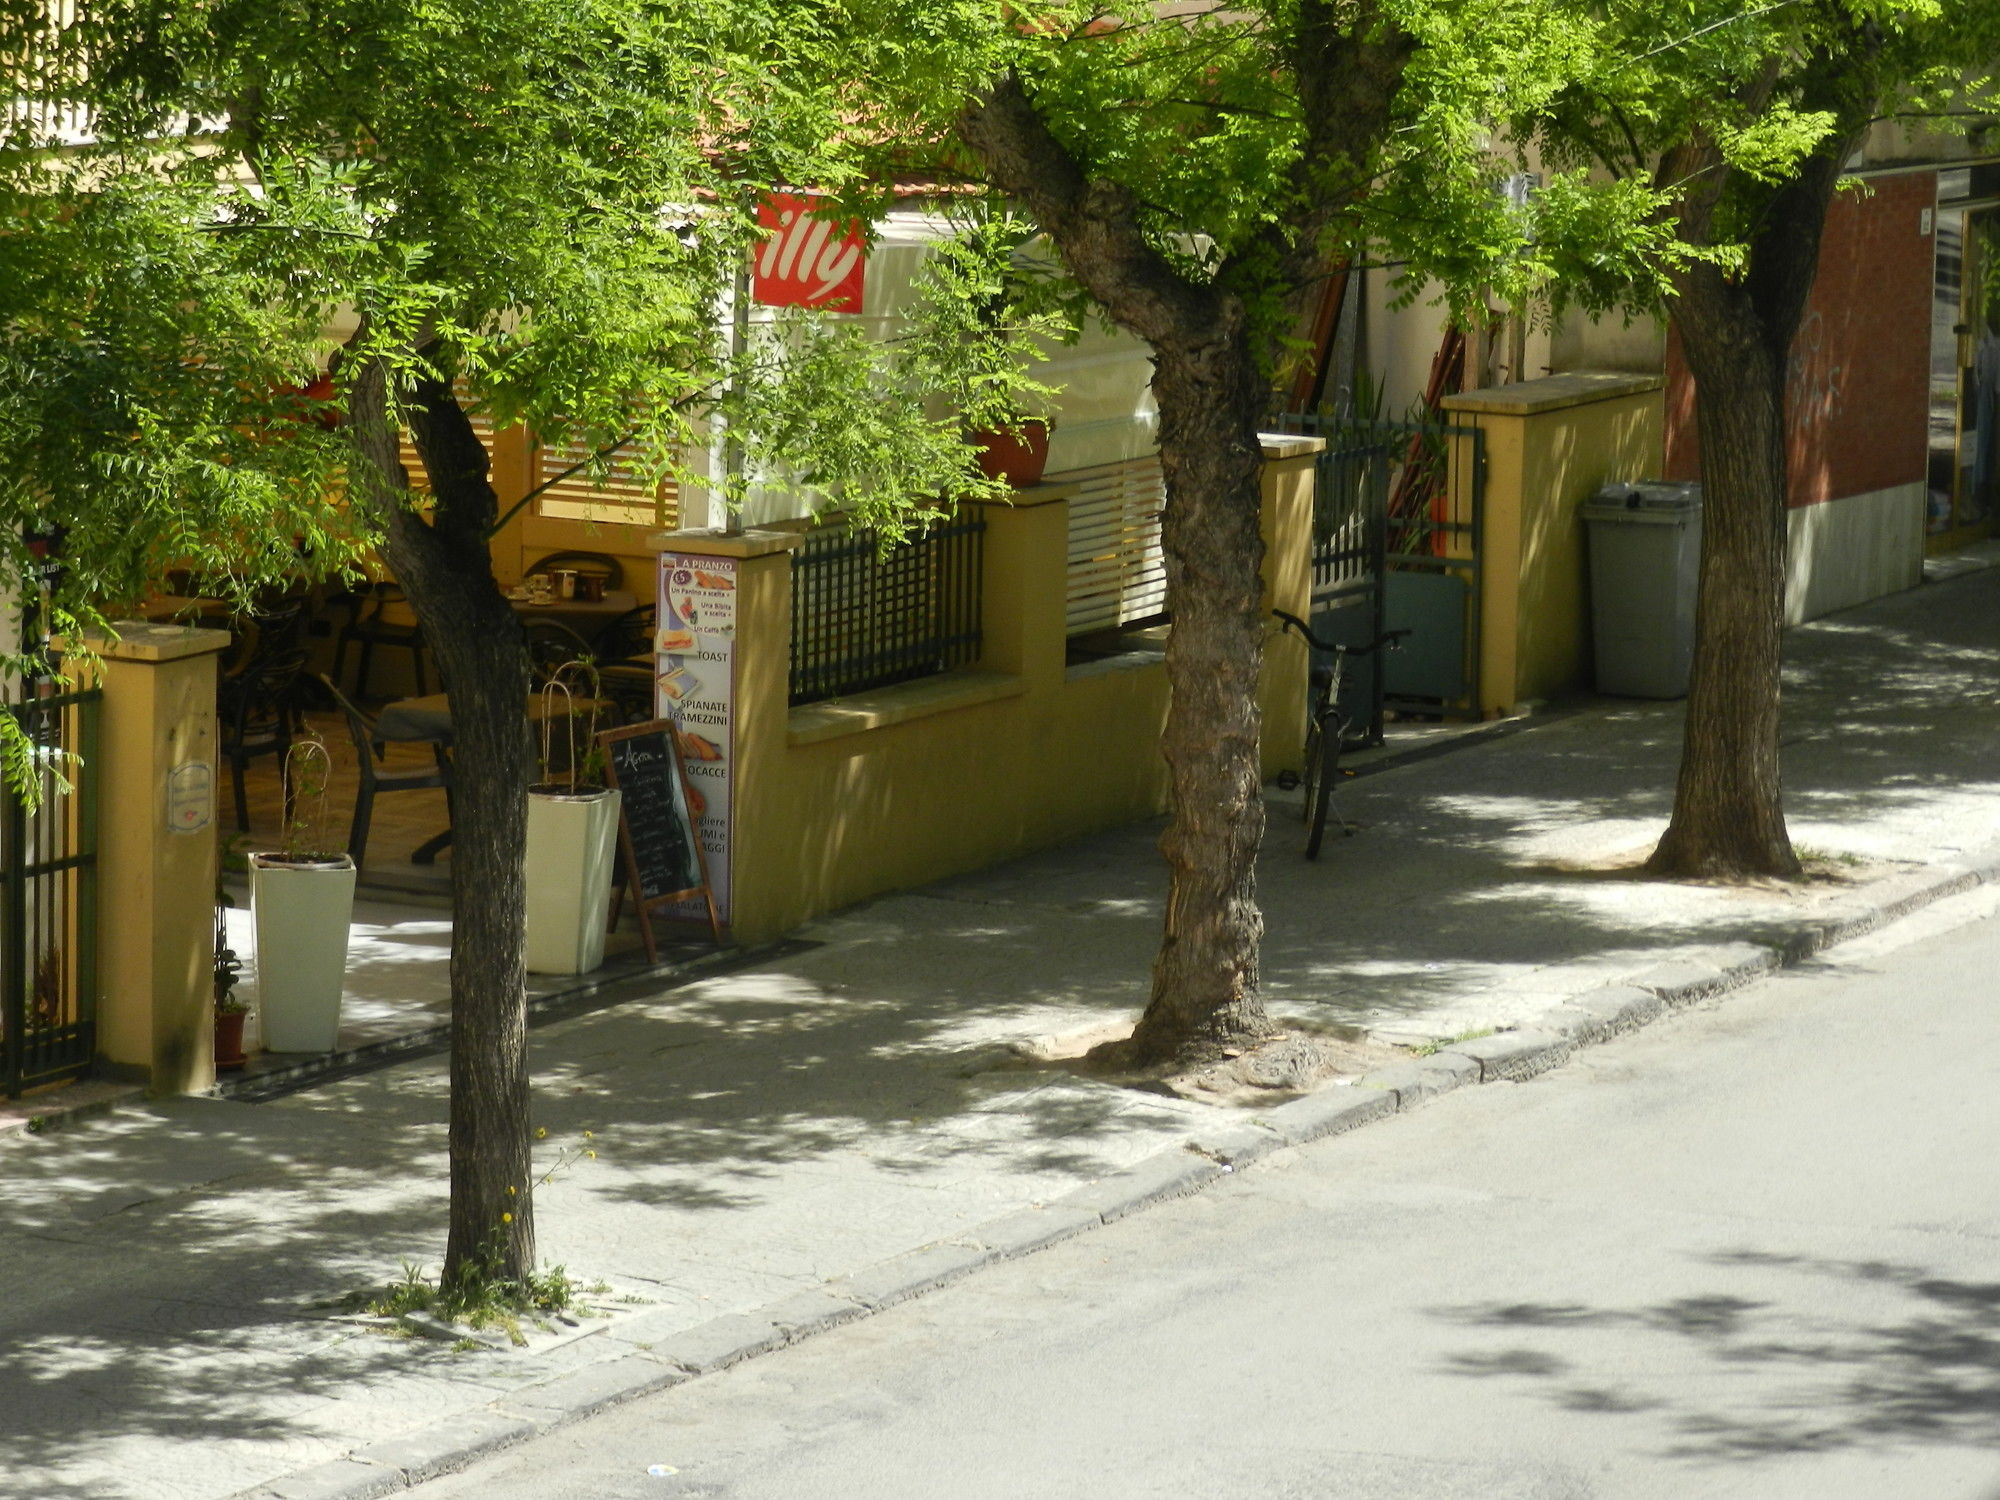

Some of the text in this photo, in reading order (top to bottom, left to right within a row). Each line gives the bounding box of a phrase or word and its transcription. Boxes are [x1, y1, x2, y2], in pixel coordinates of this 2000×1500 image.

[759, 209, 860, 300] illy
[682, 559, 733, 571] A PRANZO
[682, 588, 702, 596] Panino
[697, 650, 728, 663] TOAST
[680, 699, 727, 713] SPIANATE
[669, 711, 727, 726] TRAMEZZINI
[687, 765, 727, 779] OCACCE
[697, 815, 725, 827] gliere
